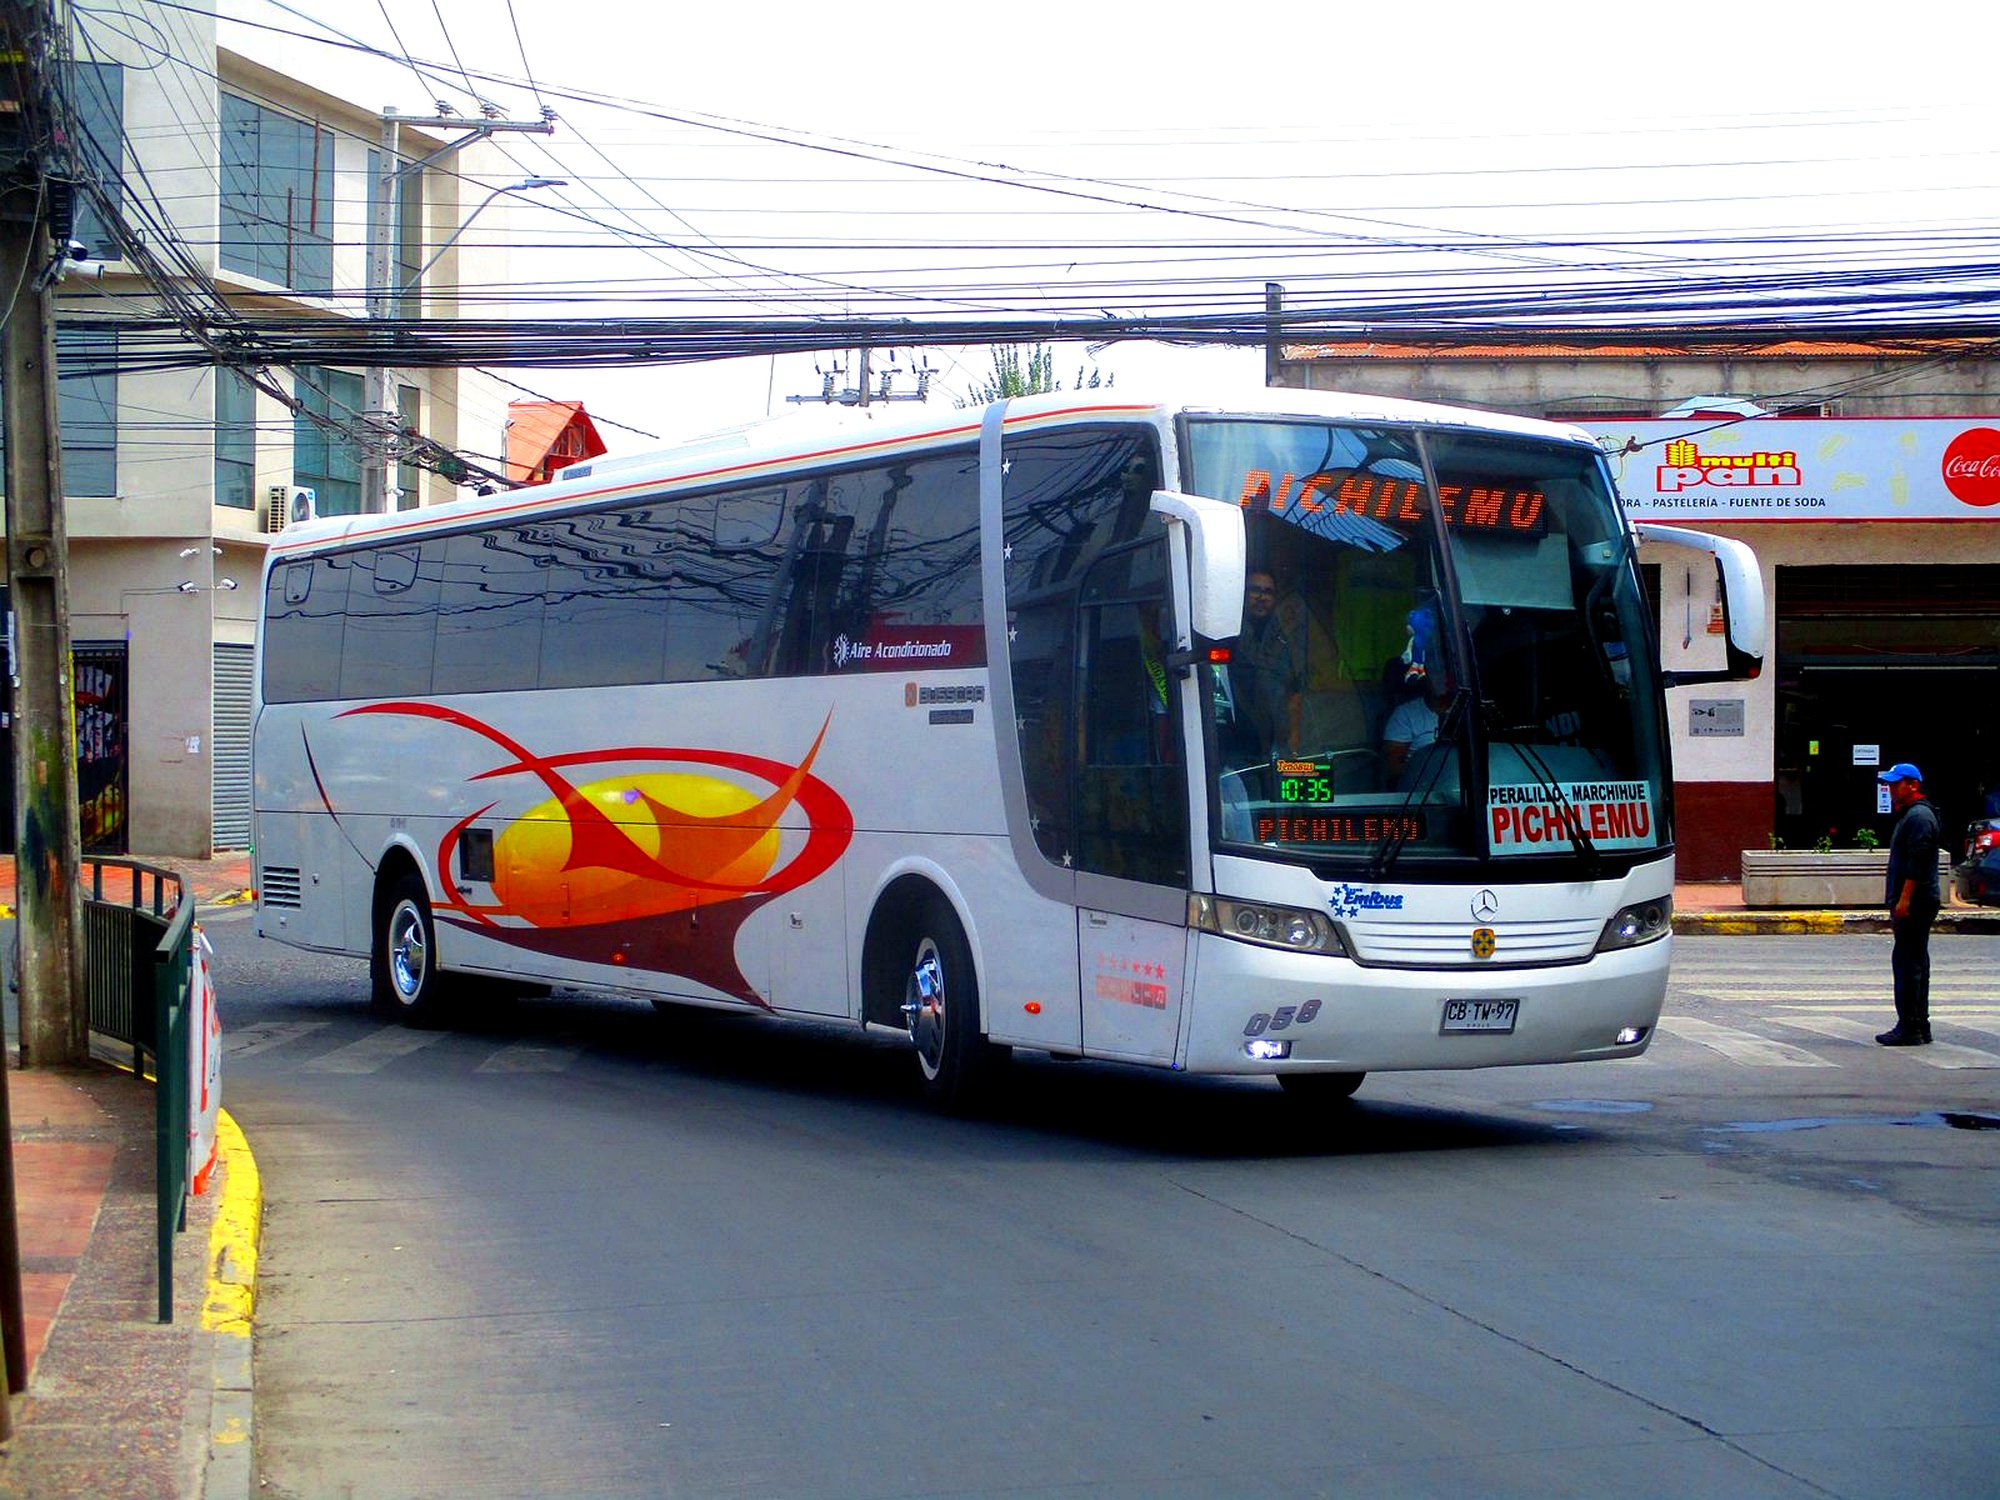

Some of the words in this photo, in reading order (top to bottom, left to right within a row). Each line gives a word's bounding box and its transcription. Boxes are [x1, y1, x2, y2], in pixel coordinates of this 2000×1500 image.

[1700, 451, 1795, 467] multi
[1657, 465, 1800, 492] pan
[1239, 470, 1545, 528] PICHILEMU
[1652, 496, 1718, 508] PASTELERÍA
[1729, 498, 1772, 508] FUENTE
[1777, 498, 1790, 507] DE
[1794, 497, 1826, 508] SODA
[849, 642, 871, 658] Aire
[874, 640, 951, 659] Acondicionado
[1281, 779, 1331, 801] 10:35
[1490, 785, 1560, 804] PERALILLO
[1572, 783, 1645, 801] MARCHIHUE
[1259, 818, 1418, 841] PICHILEMU
[1492, 802, 1649, 844] PICHILEMU
